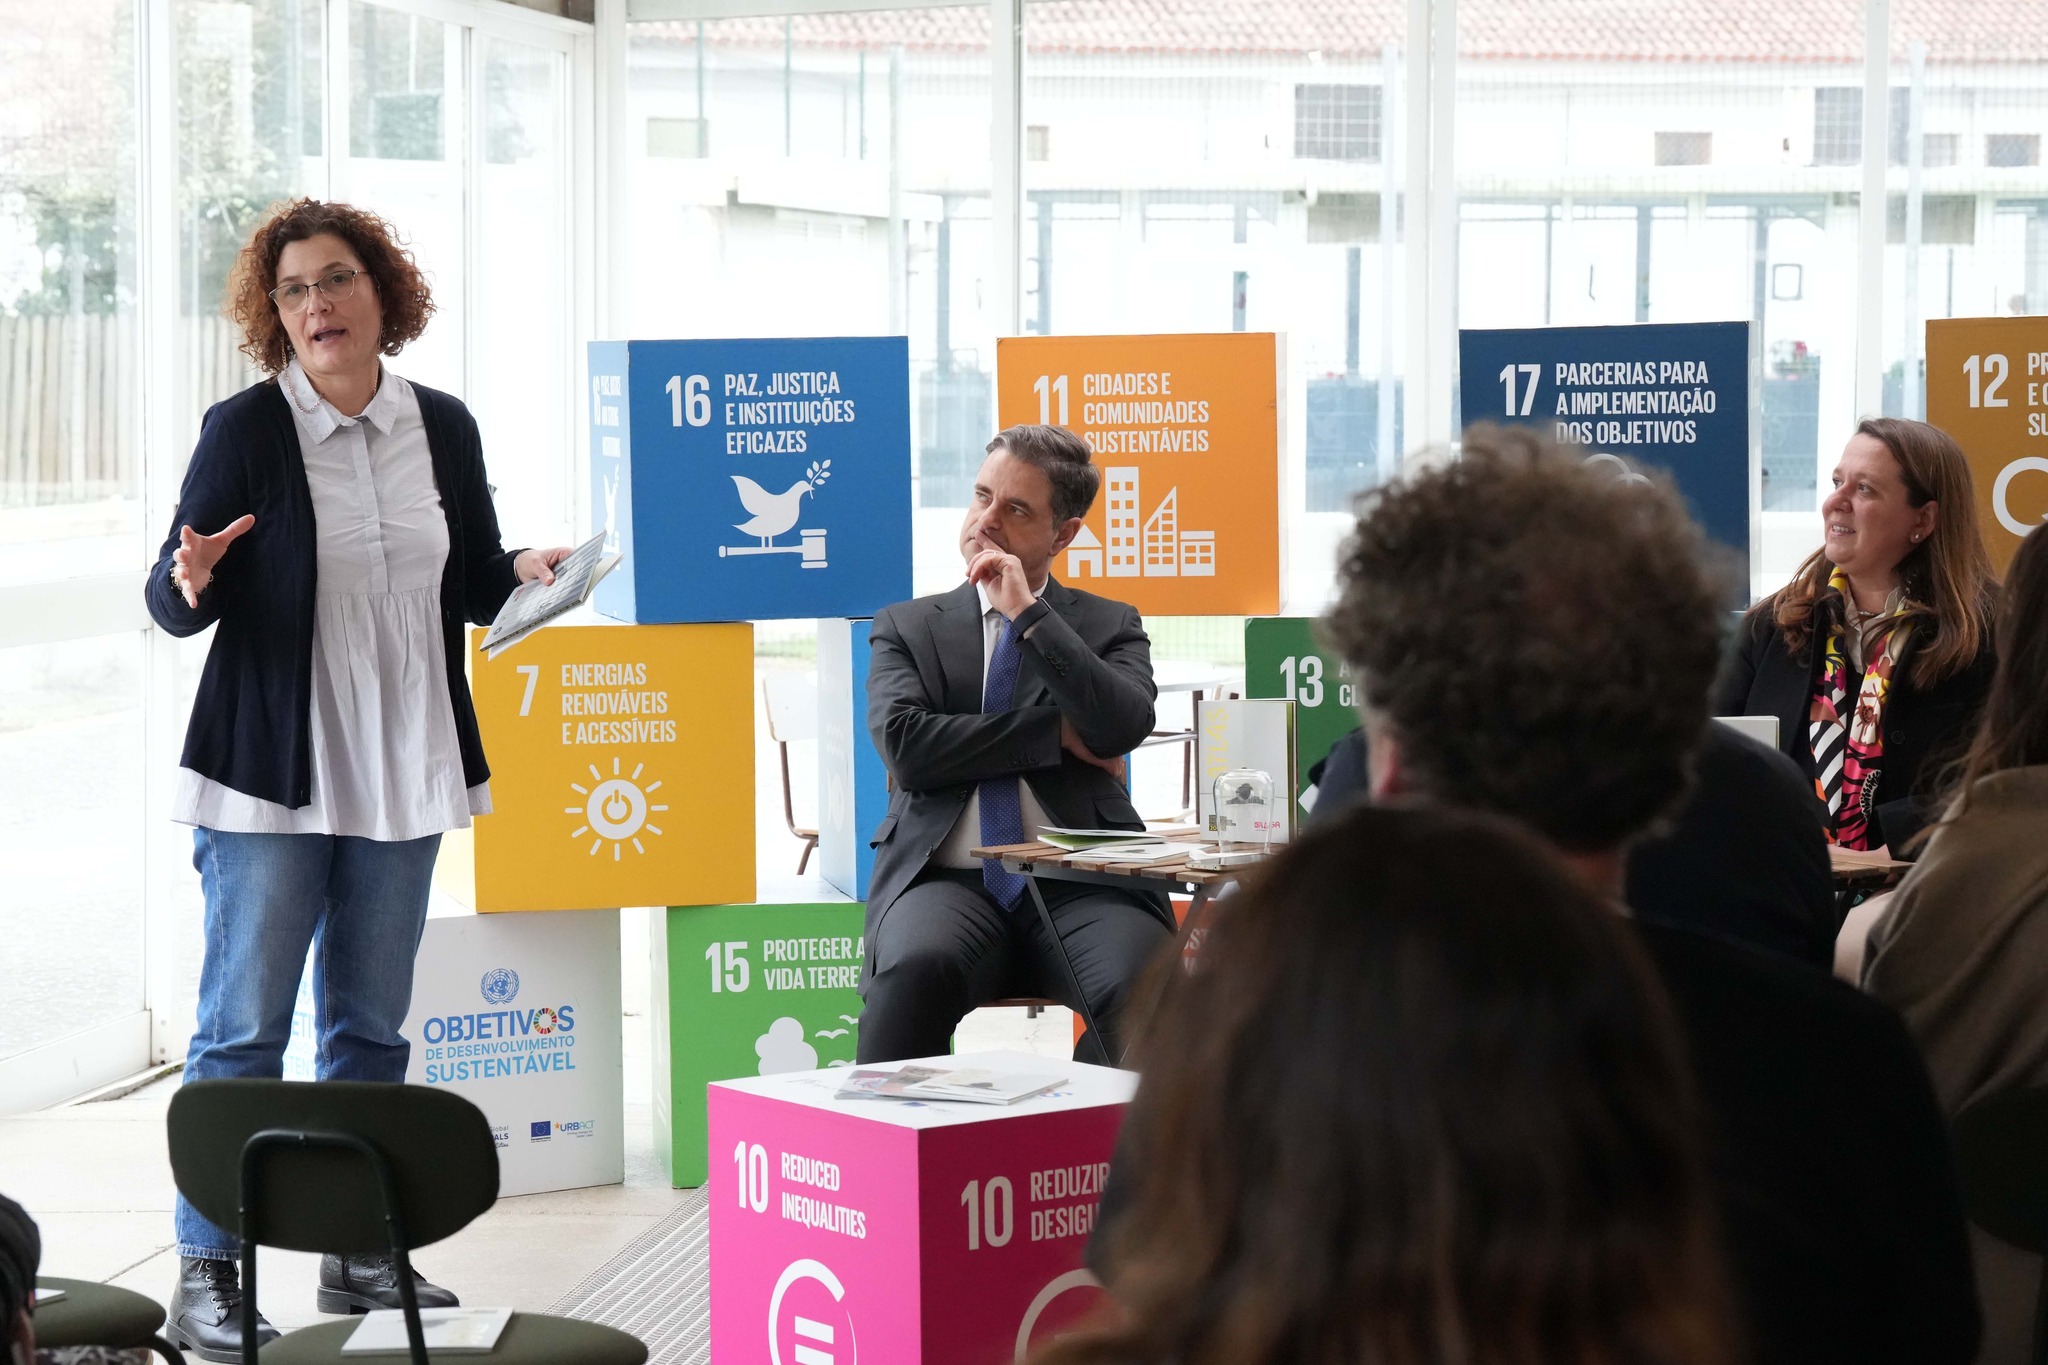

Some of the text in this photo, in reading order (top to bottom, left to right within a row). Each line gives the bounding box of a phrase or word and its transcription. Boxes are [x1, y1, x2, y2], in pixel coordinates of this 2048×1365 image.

[725, 372, 841, 397] PAZ, JUSTIÇA
[1084, 373, 1170, 396] CIDADES E
[1556, 361, 1708, 385] PARCERIAS PARA
[1963, 354, 2008, 407] 12
[666, 375, 711, 426] 16
[1033, 375, 1069, 425] 11
[1500, 364, 1540, 415] 17
[1556, 388, 1715, 416] A IMPLEMENTAÇÃO
[2029, 383, 2038, 405] E
[726, 397, 855, 426] E INSTITUIÇÕES
[1084, 401, 1209, 424] COMUNIDADES
[727, 430, 806, 454] EFICAZES
[1084, 427, 1209, 453] SUSTENTÁVEIS
[1556, 421, 1696, 444] DOS OBJETIVOS
[562, 663, 646, 686] ENERGIAS
[1280, 655, 1324, 708] 13
[517, 665, 539, 716] 7
[562, 689, 667, 715] RENOVÁVEIS
[562, 718, 676, 744] E ACESSÍVEIS
[764, 937, 865, 961] PROTEGER A
[706, 942, 749, 992] 15
[764, 966, 862, 990] VIDA TERRE
[423, 1005, 575, 1044] OBJETIVOS
[426, 1035, 575, 1060] DE DESENVOLVIMENTO
[425, 1051, 576, 1084] SUSTENTÁVEL
[735, 1141, 768, 1213] 10
[782, 1152, 840, 1191] REDUCED
[1030, 1162, 1110, 1202] REDUZIR
[782, 1191, 866, 1240] INEQUALITIES
[961, 1176, 1013, 1250] 10
